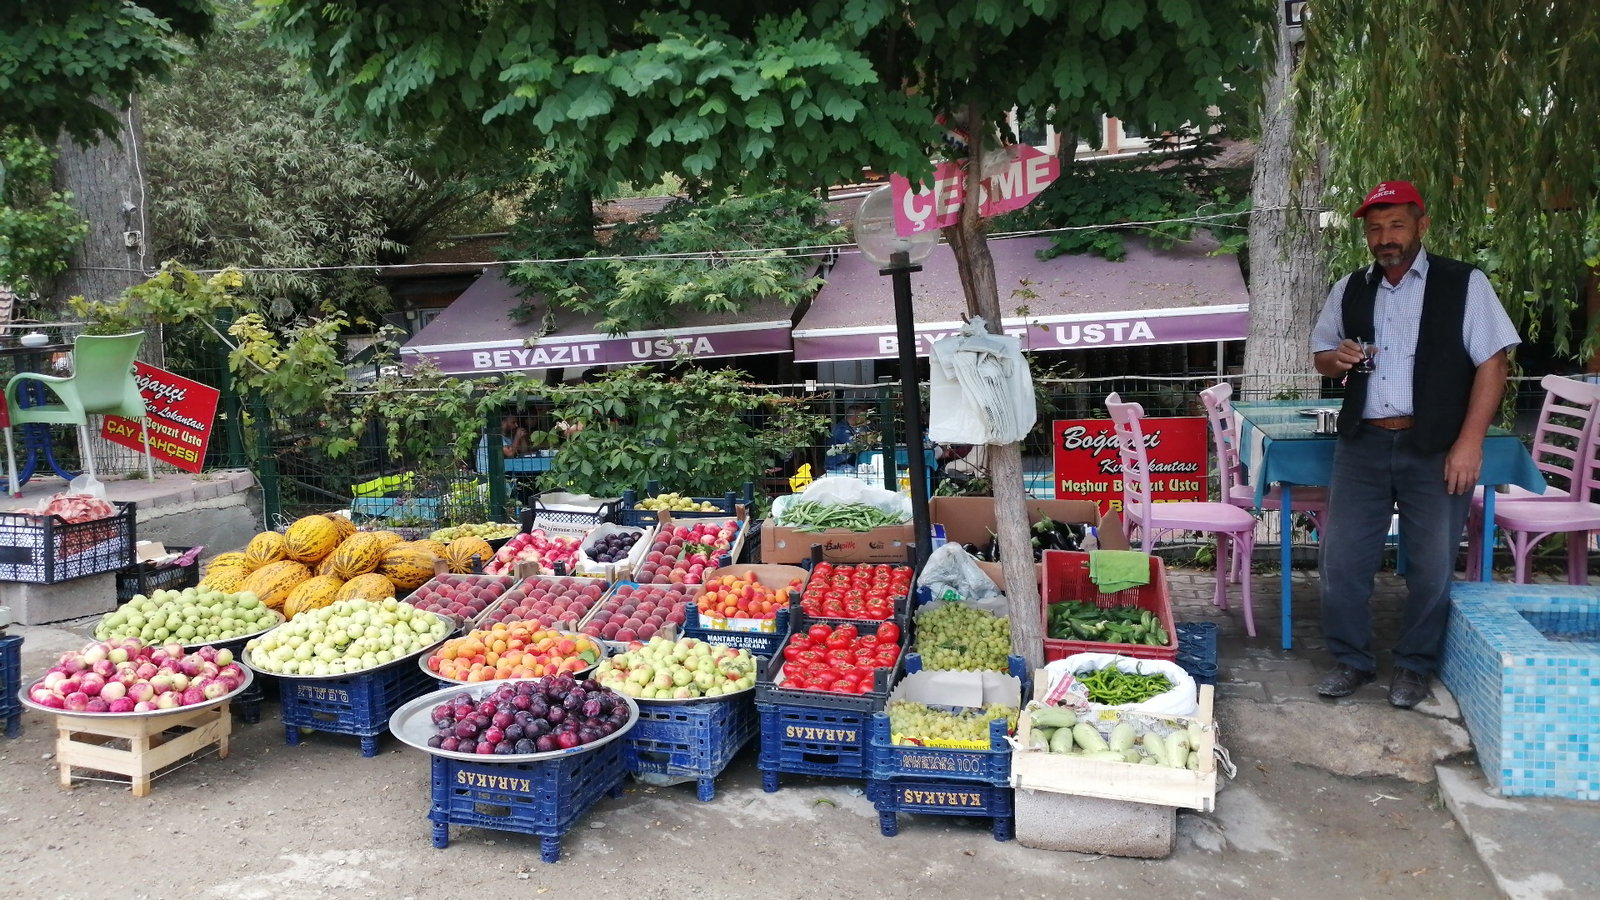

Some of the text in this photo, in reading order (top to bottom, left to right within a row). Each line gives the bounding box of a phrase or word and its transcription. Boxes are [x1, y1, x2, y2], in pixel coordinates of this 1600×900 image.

[1056, 321, 1155, 345] USTA
[472, 336, 715, 369] BEYAZIT USTA
[131, 364, 187, 404] oğaziçi
[106, 420, 135, 438] ÇAY
[158, 406, 205, 431] Lokantası
[181, 431, 202, 447] Usta
[1061, 479, 1108, 495] Meşhur
[1169, 479, 1200, 491] Usta
